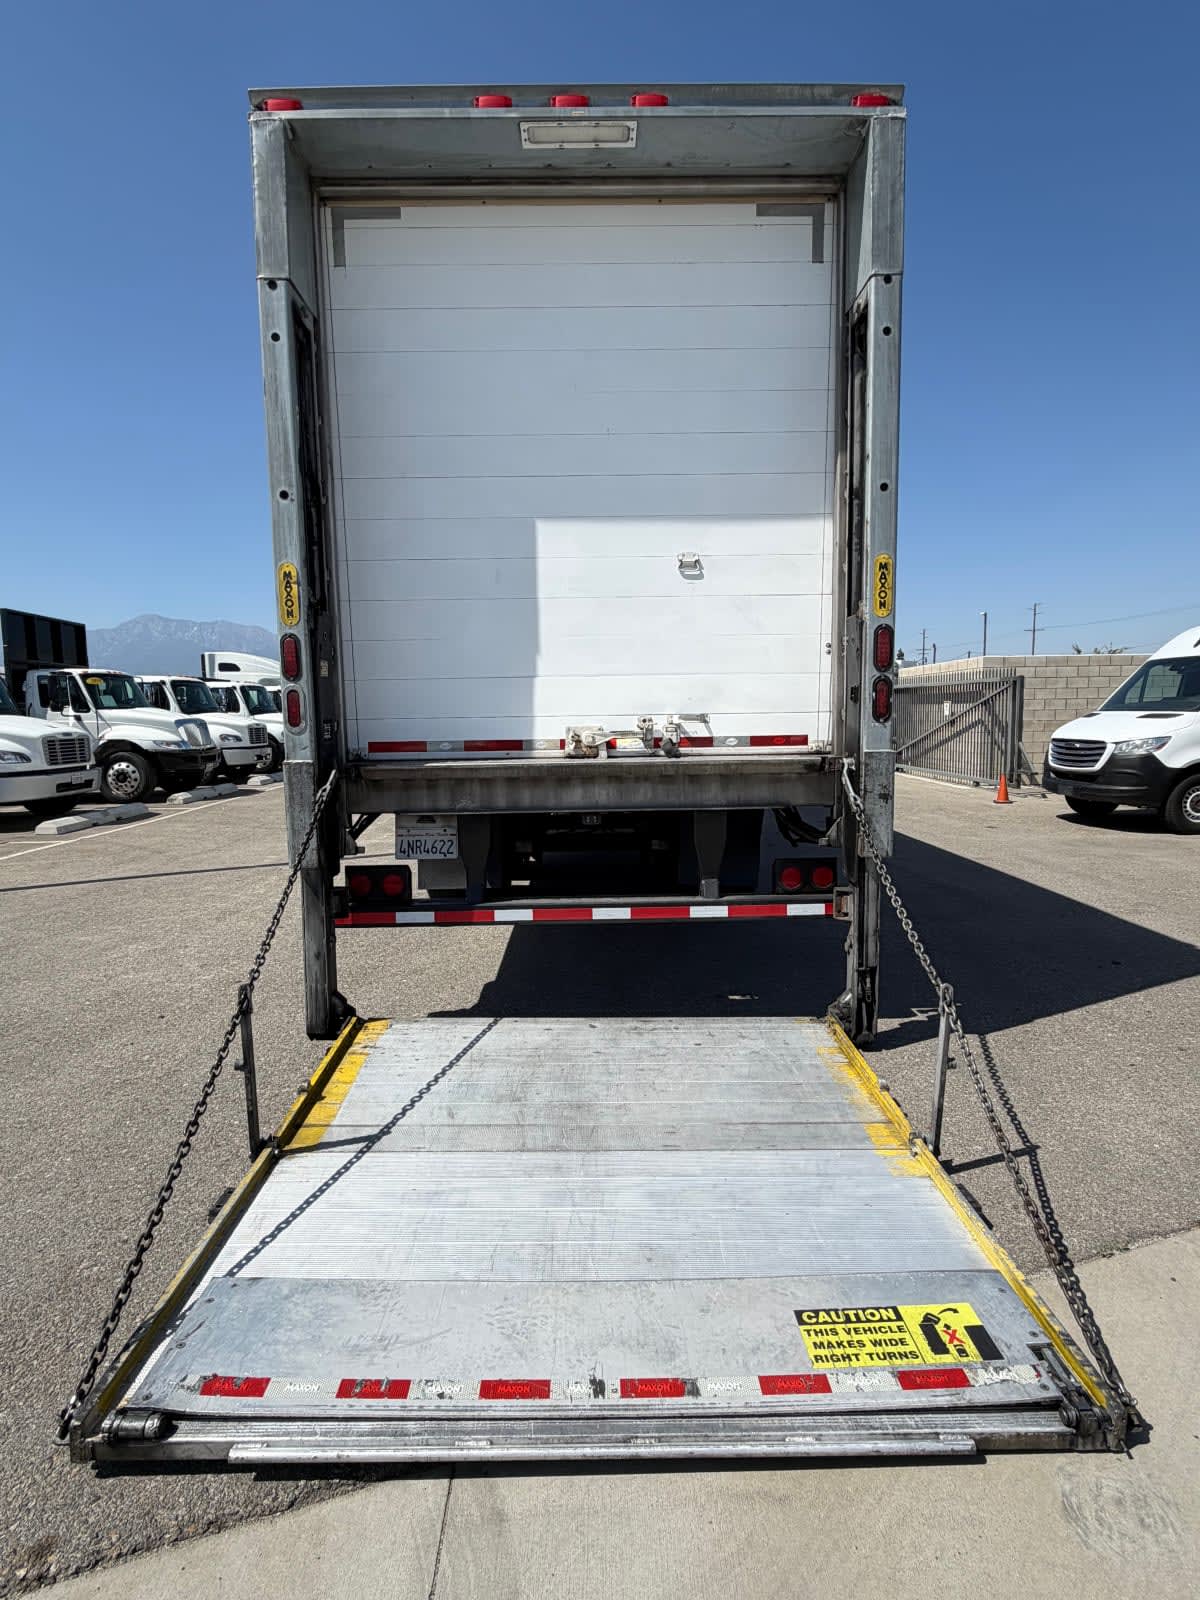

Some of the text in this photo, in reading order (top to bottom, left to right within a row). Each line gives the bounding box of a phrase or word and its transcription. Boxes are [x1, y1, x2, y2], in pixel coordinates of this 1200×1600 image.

[878, 562, 889, 609] MAXON
[282, 570, 294, 619] MAXON
[400, 839, 454, 855] 4NR4622
[801, 1308, 896, 1324] CAUTION
[803, 1324, 907, 1338] THIS VEHICLE
[812, 1337, 909, 1351] MAKES WIDE
[813, 1350, 920, 1364] RIGHT TURNS
[285, 1382, 320, 1392] MAXON
[427, 1384, 463, 1394] MAXON
[497, 1385, 530, 1393] MAXON
[638, 1384, 671, 1393] MAXON
[707, 1382, 743, 1391] MAXON
